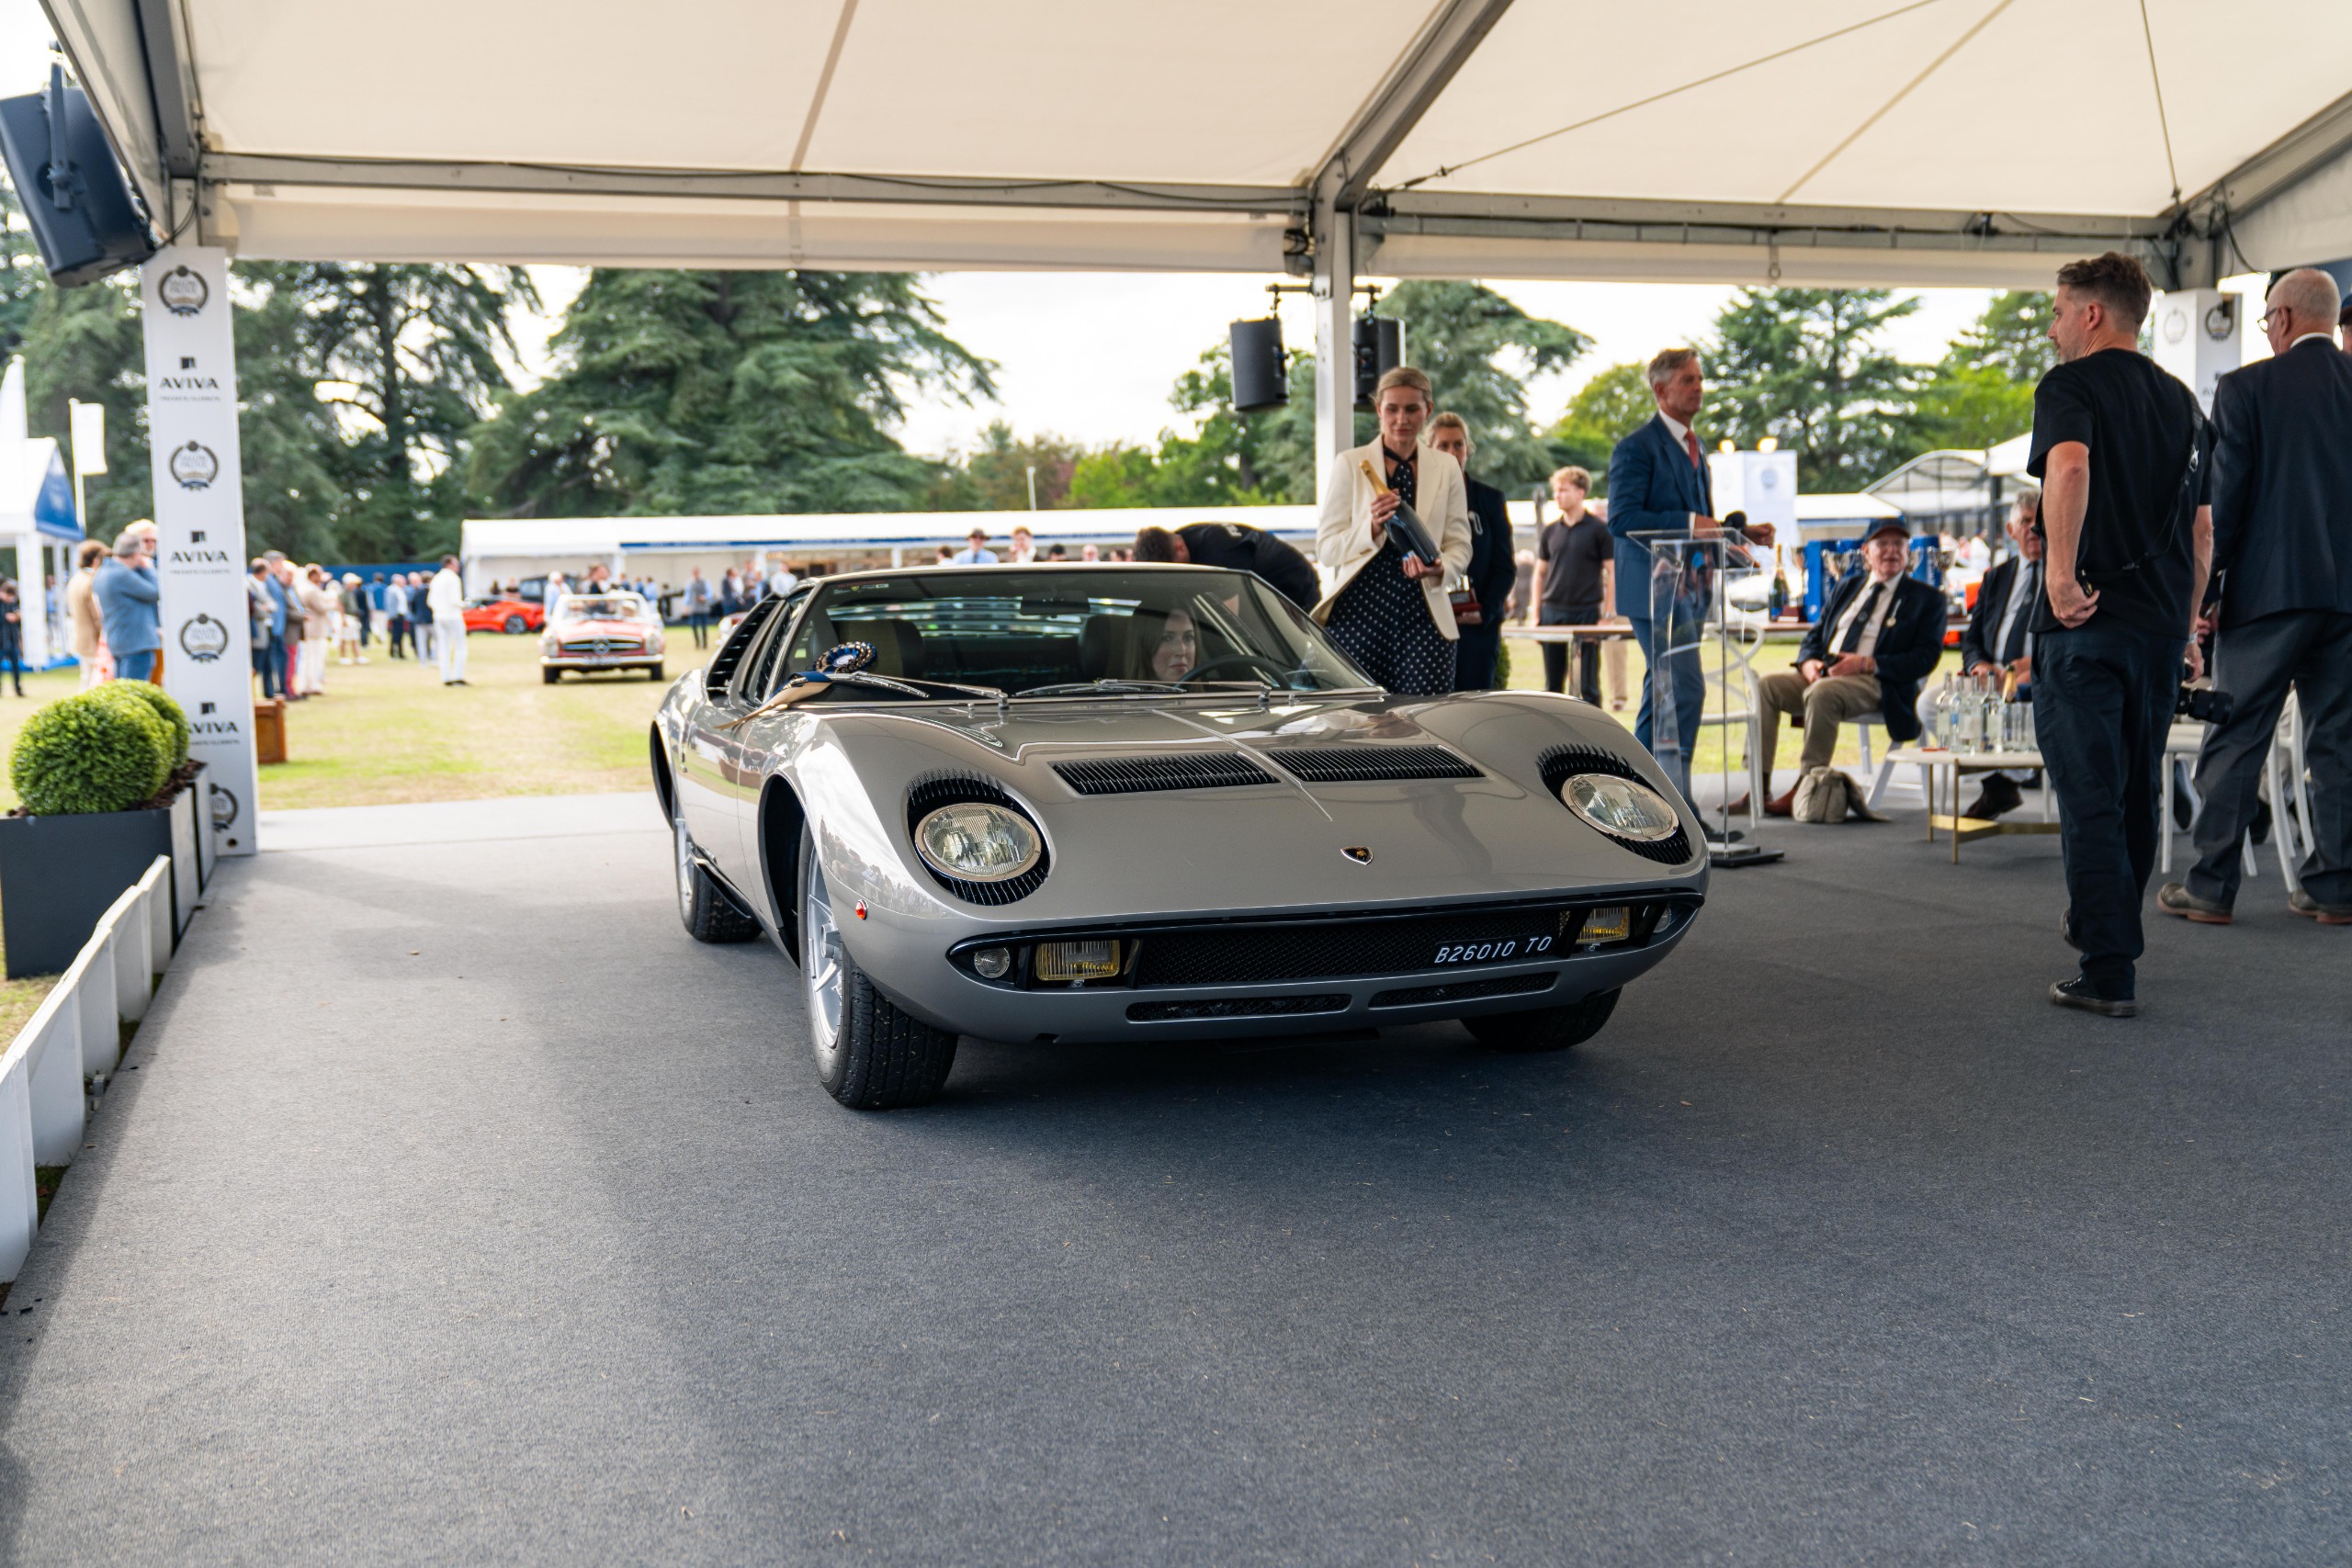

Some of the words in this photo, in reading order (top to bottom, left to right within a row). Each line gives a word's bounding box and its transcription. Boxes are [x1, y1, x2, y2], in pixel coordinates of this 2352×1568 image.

[160, 376, 220, 389] AVIVA
[170, 550, 229, 563] AVIVA
[1434, 941, 1516, 964] B26010
[1525, 936, 1553, 953] TO
